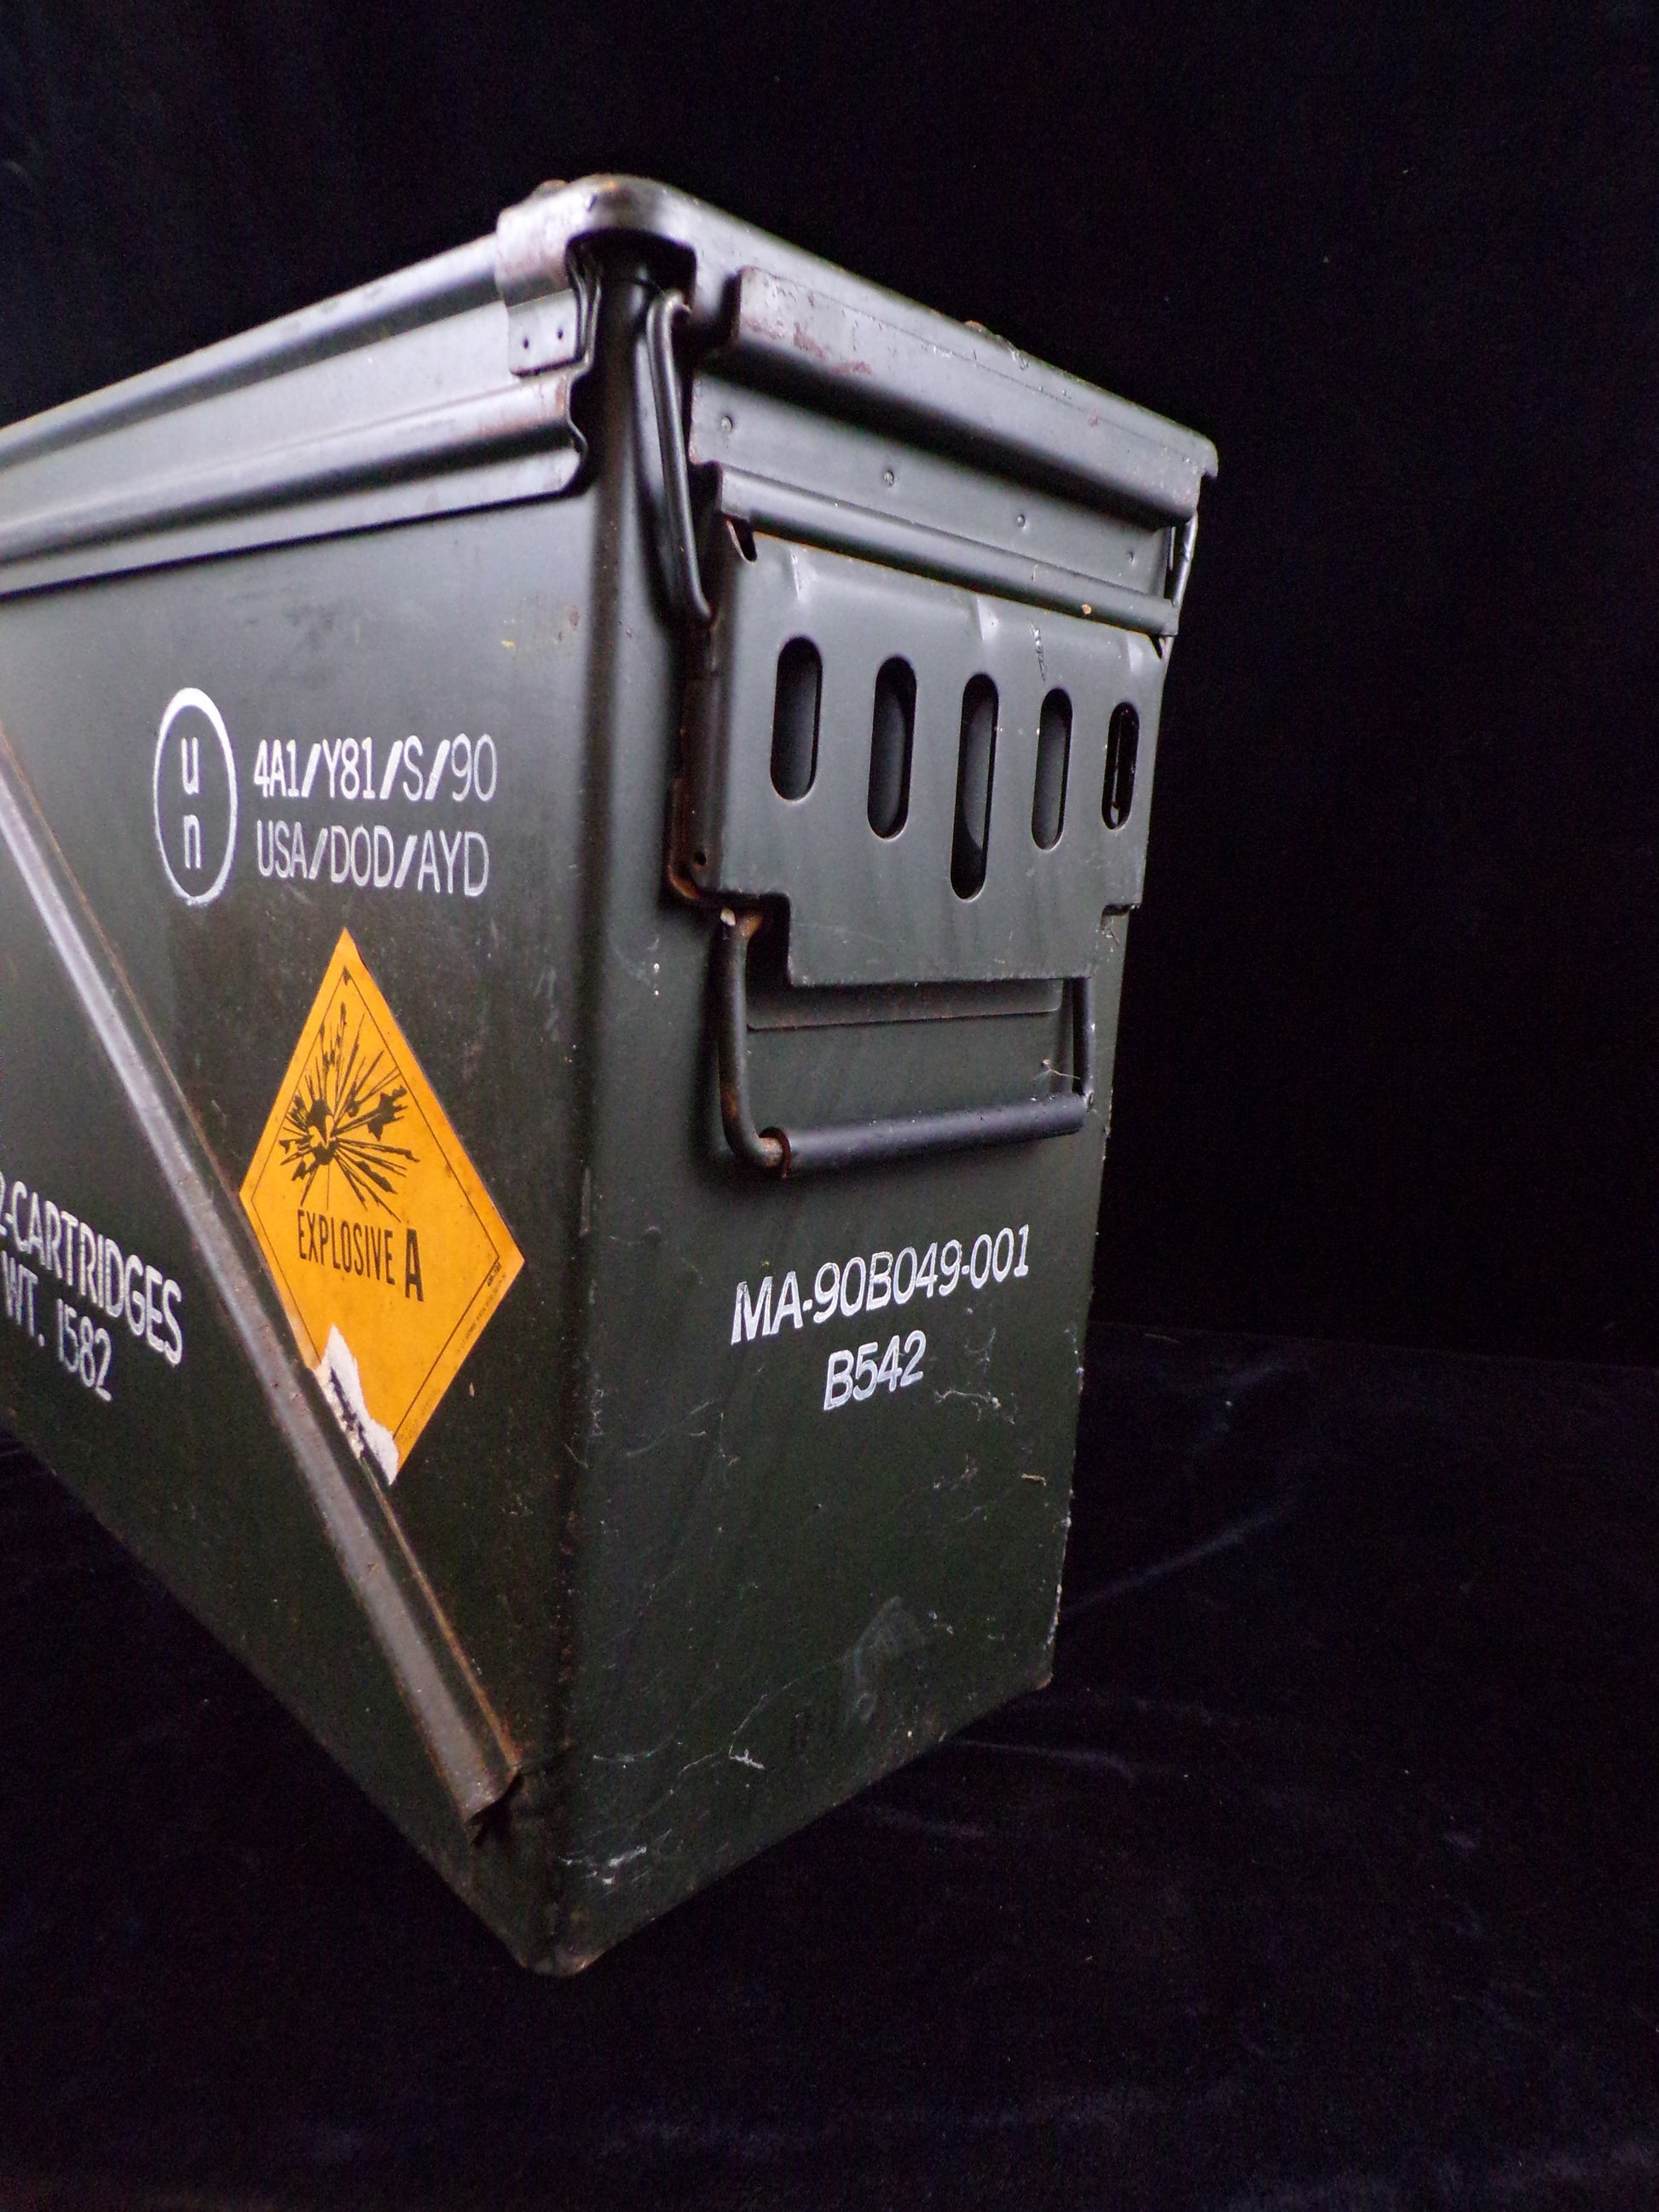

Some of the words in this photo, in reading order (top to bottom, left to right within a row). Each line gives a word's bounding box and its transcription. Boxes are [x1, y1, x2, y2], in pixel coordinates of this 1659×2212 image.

[254, 733, 497, 802] 4A1/Y81/S/90
[257, 819, 489, 897] USA/DOD/AYD
[297, 1209, 396, 1285] EXPLOSIVE
[405, 1227, 424, 1302] A
[731, 1224, 1029, 1346] MA-90B049-001
[56, 1298, 113, 1401] 1582
[824, 1330, 927, 1412] B542
